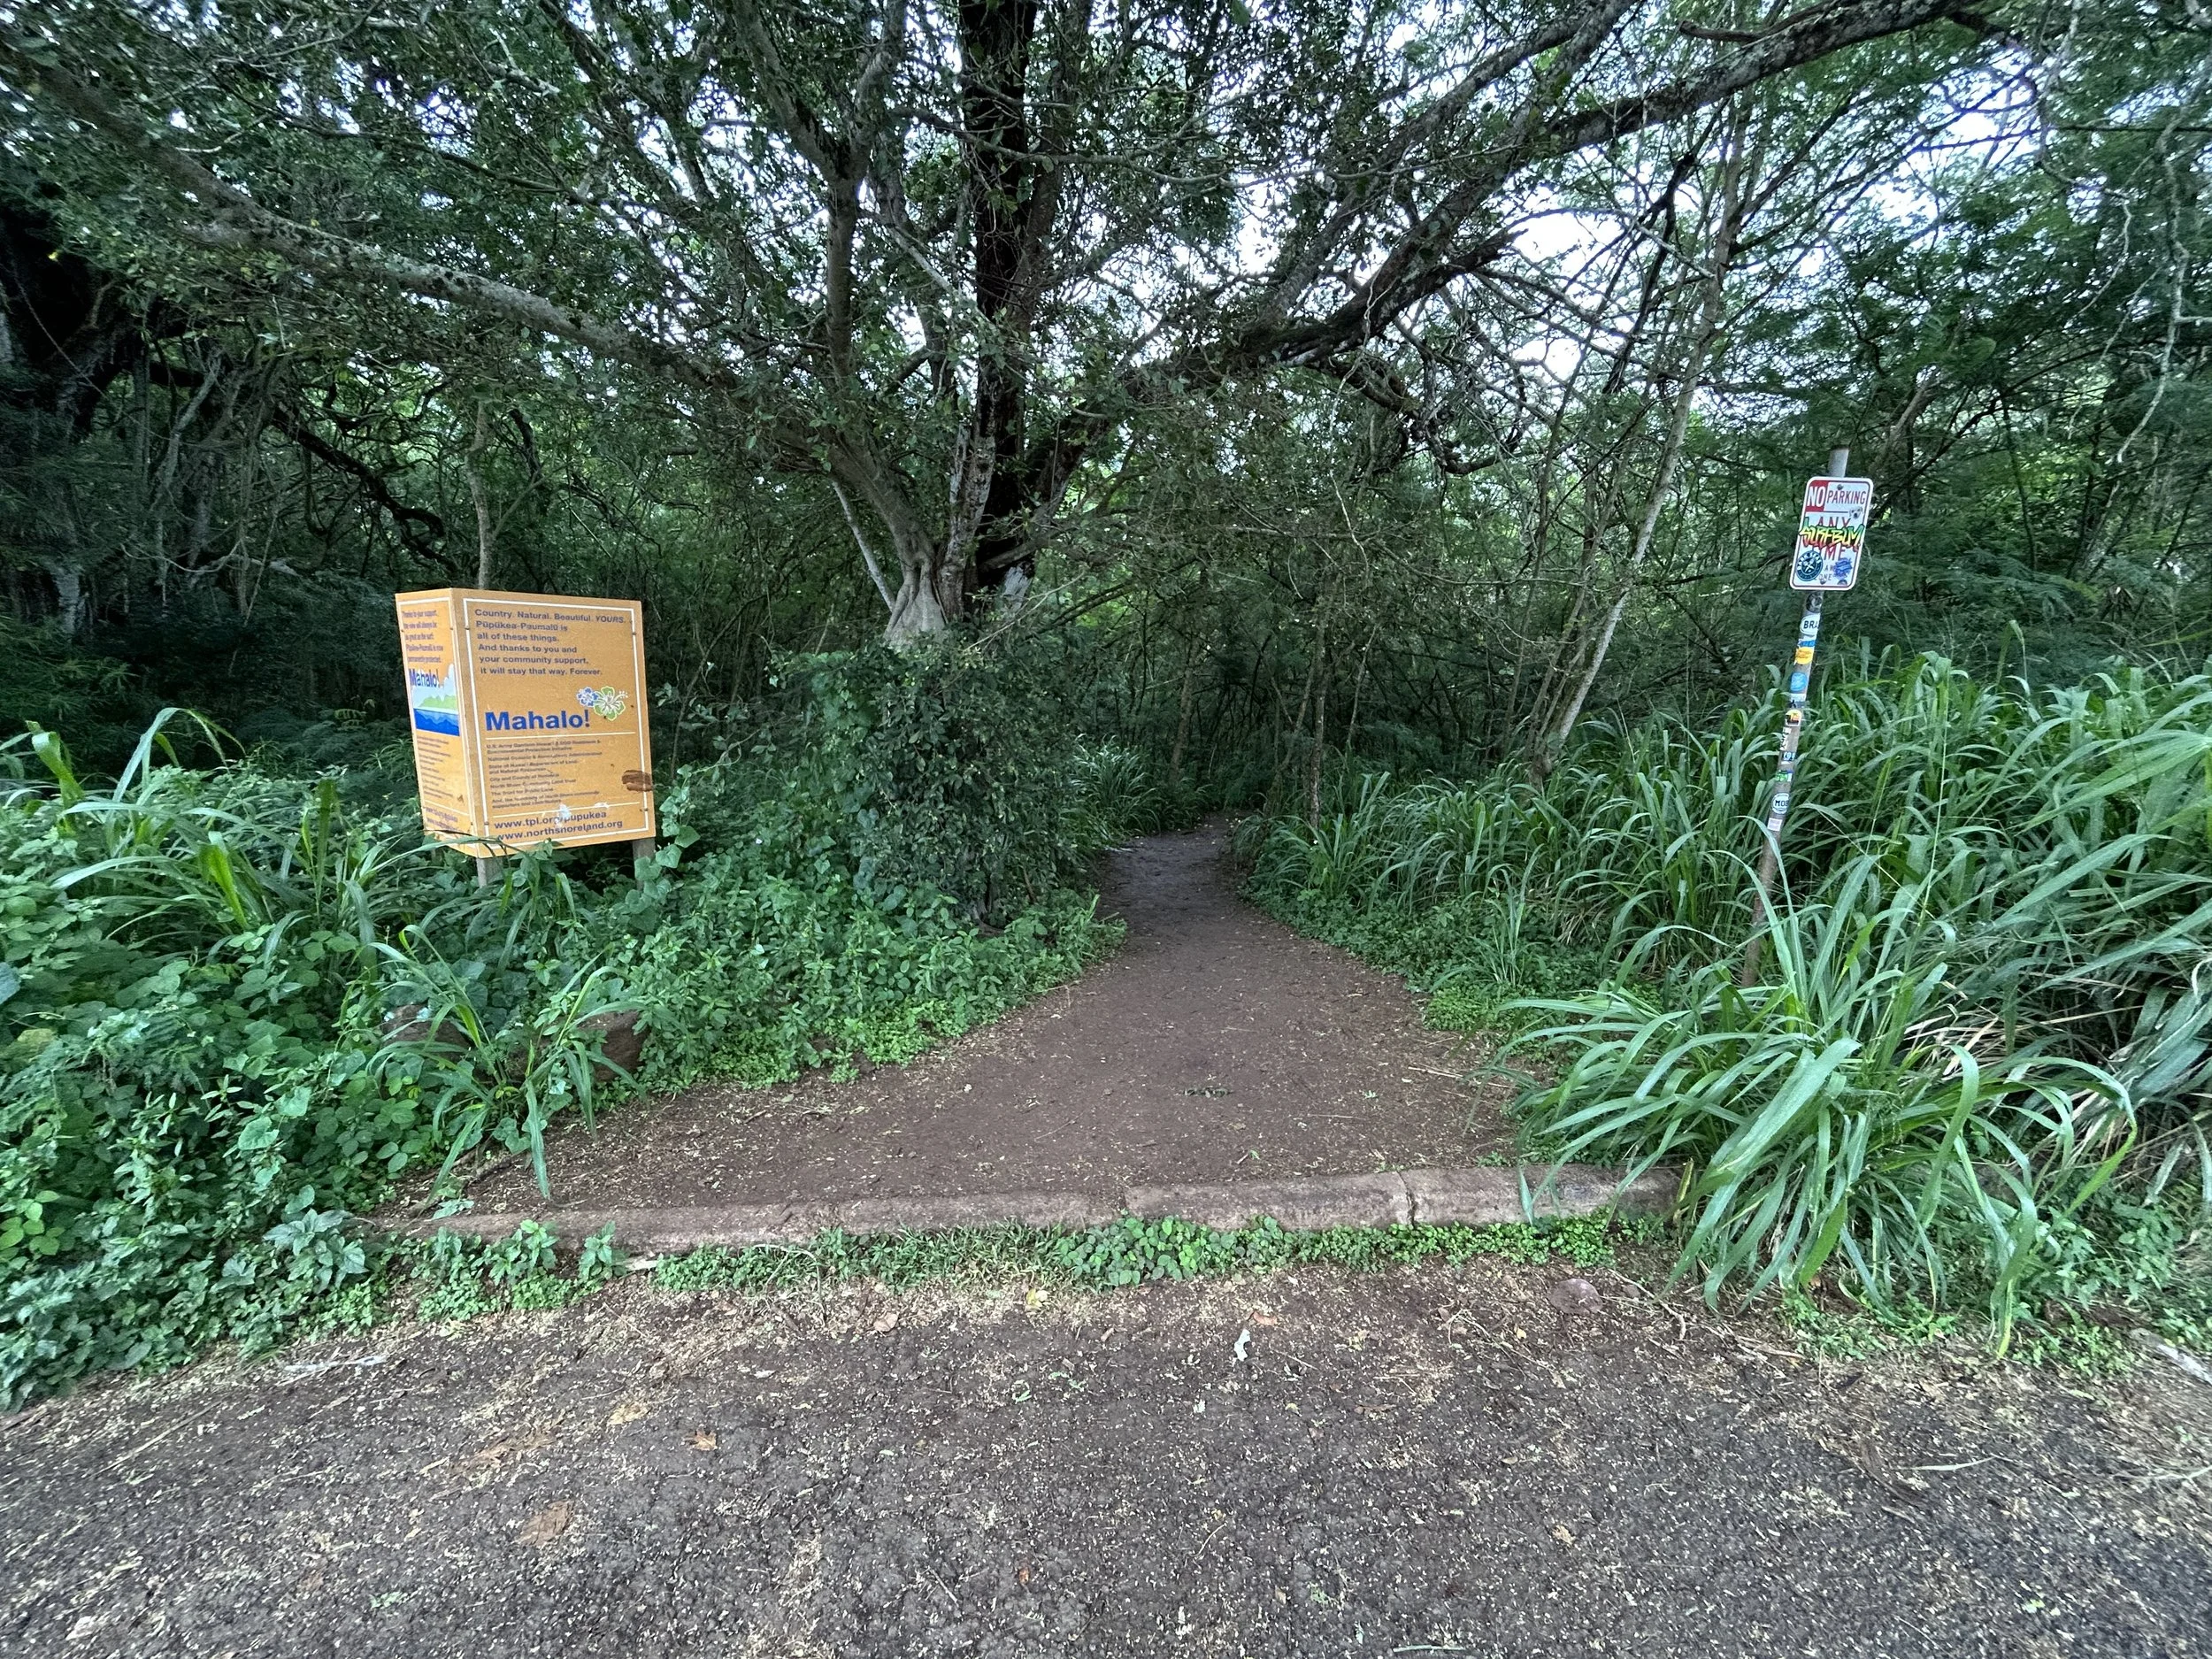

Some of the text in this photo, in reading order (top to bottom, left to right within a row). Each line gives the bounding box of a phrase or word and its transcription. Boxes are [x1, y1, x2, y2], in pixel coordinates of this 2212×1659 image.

[1807, 486, 1866, 507] NO PARKING
[474, 609, 515, 618] Country.
[517, 611, 552, 620] Natural.
[595, 615, 626, 624] YOURS.
[530, 634, 559, 643] things.
[503, 656, 552, 664] community
[409, 668, 441, 688] Mahalo!
[485, 709, 590, 731] Mahalo!
